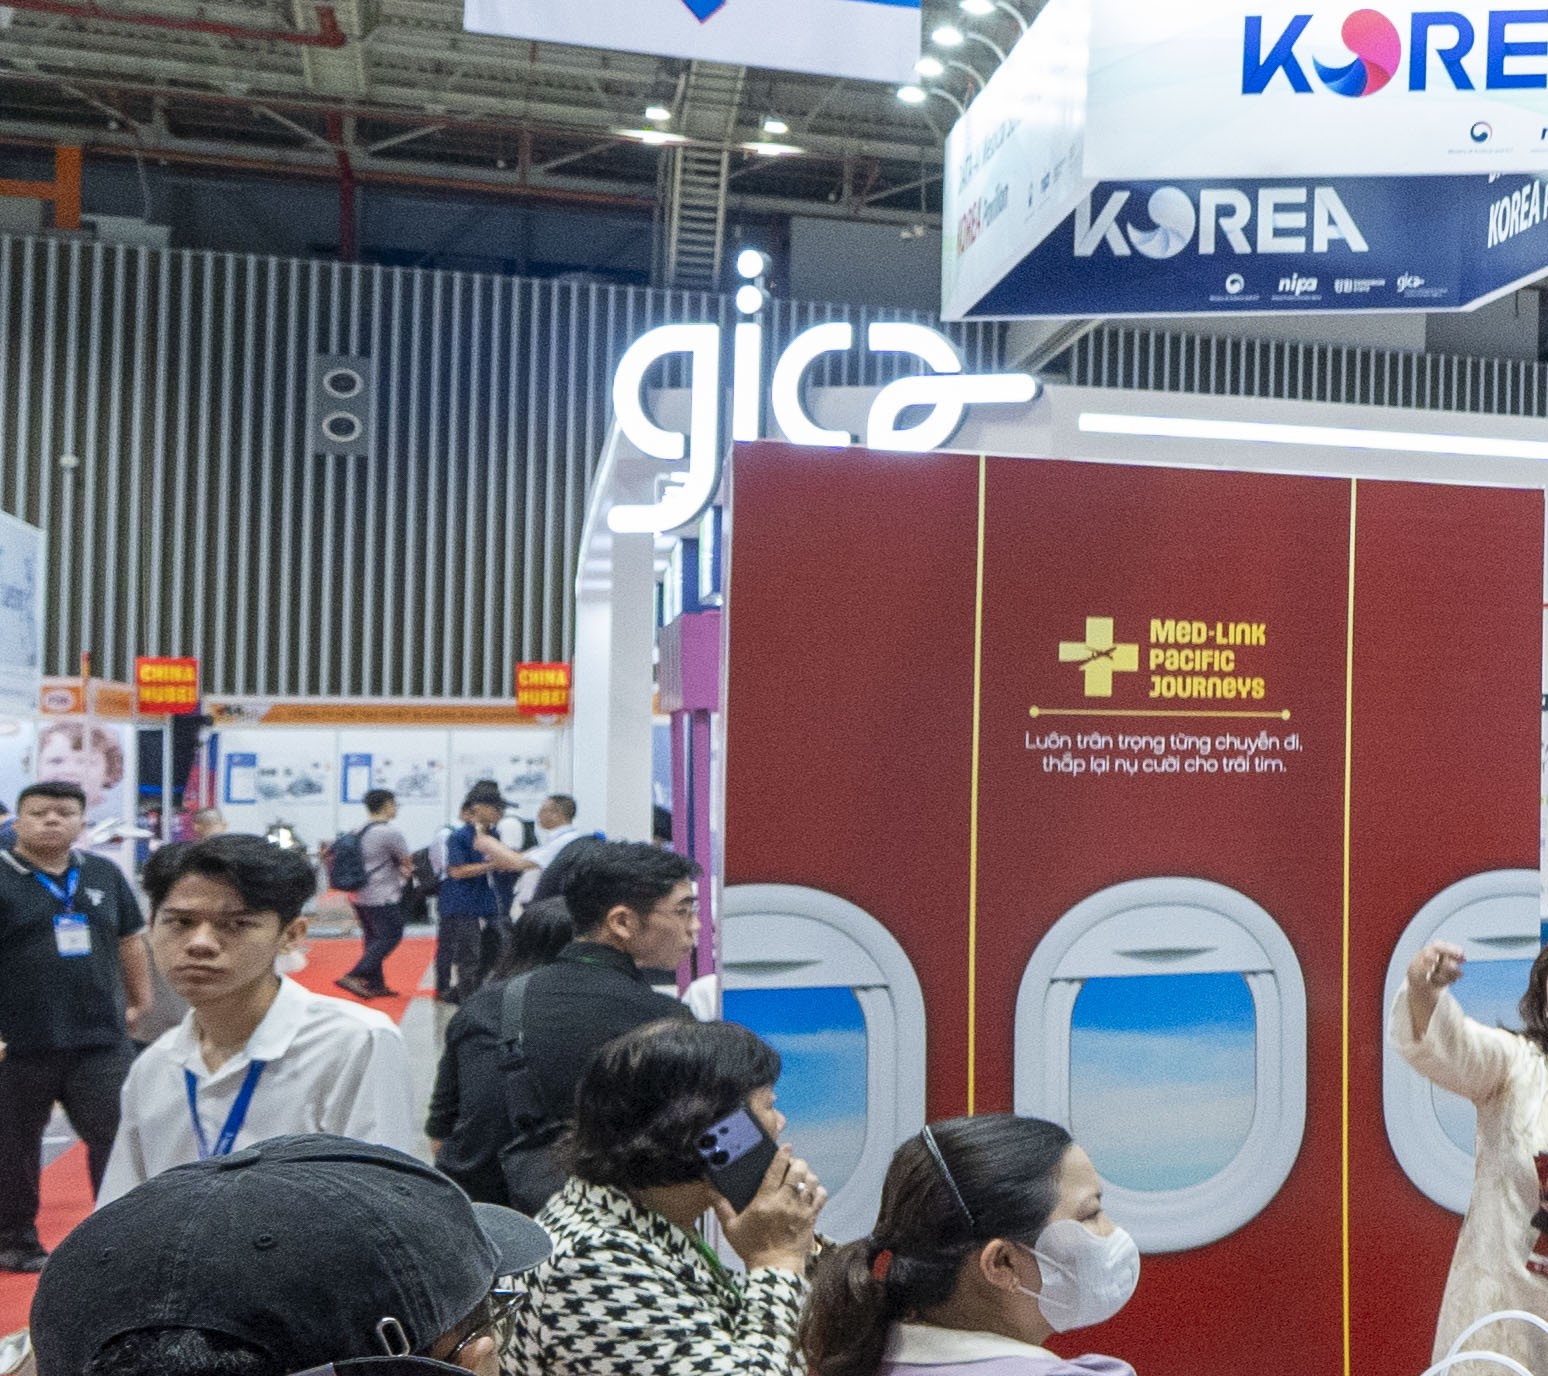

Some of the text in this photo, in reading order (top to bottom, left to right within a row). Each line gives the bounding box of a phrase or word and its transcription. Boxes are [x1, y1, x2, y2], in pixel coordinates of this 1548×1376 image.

[1073, 186, 1368, 260] KOREA
[1487, 180, 1540, 248] KOREA
[607, 249, 1034, 534] gica
[518, 669, 565, 686] CHINA
